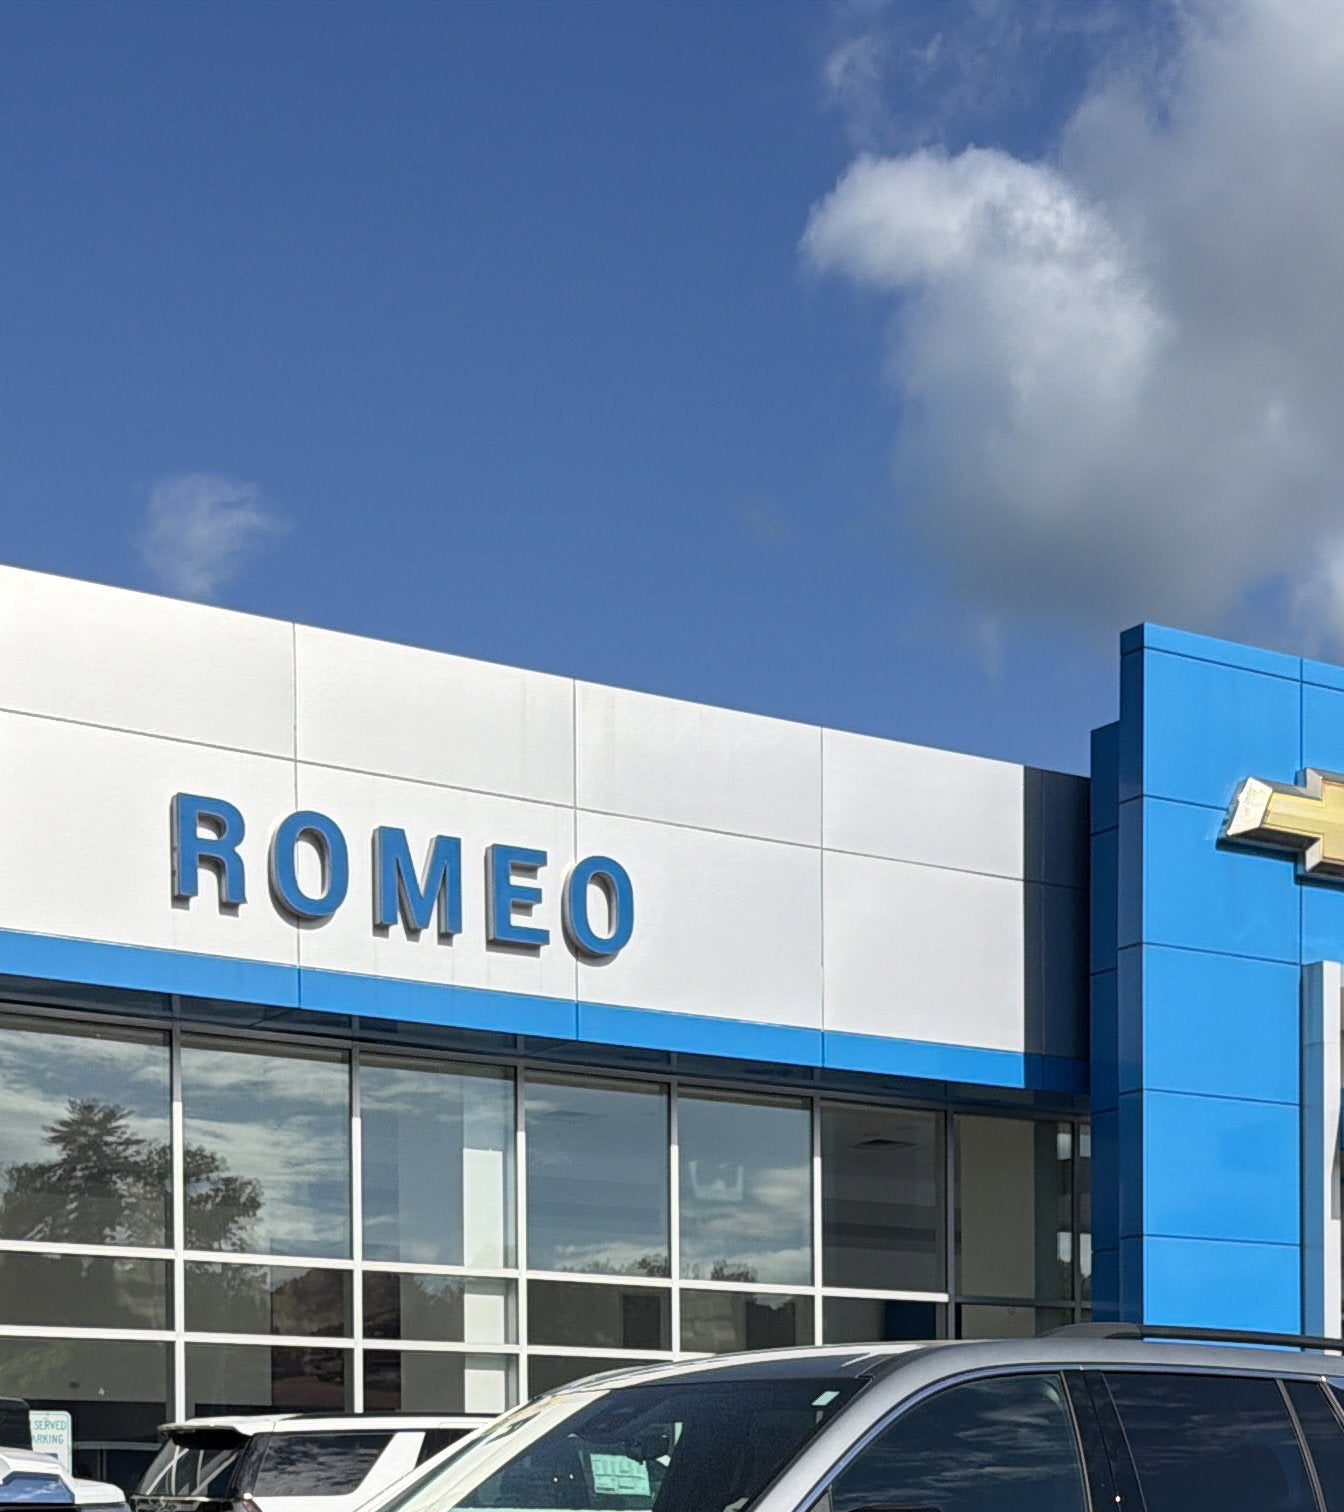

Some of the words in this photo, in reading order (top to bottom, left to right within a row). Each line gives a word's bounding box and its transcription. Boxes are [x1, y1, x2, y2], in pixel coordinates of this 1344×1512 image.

[171, 792, 635, 957] ROMEO
[34, 1420, 67, 1430] SERVED
[32, 1434, 64, 1444] ARKING
